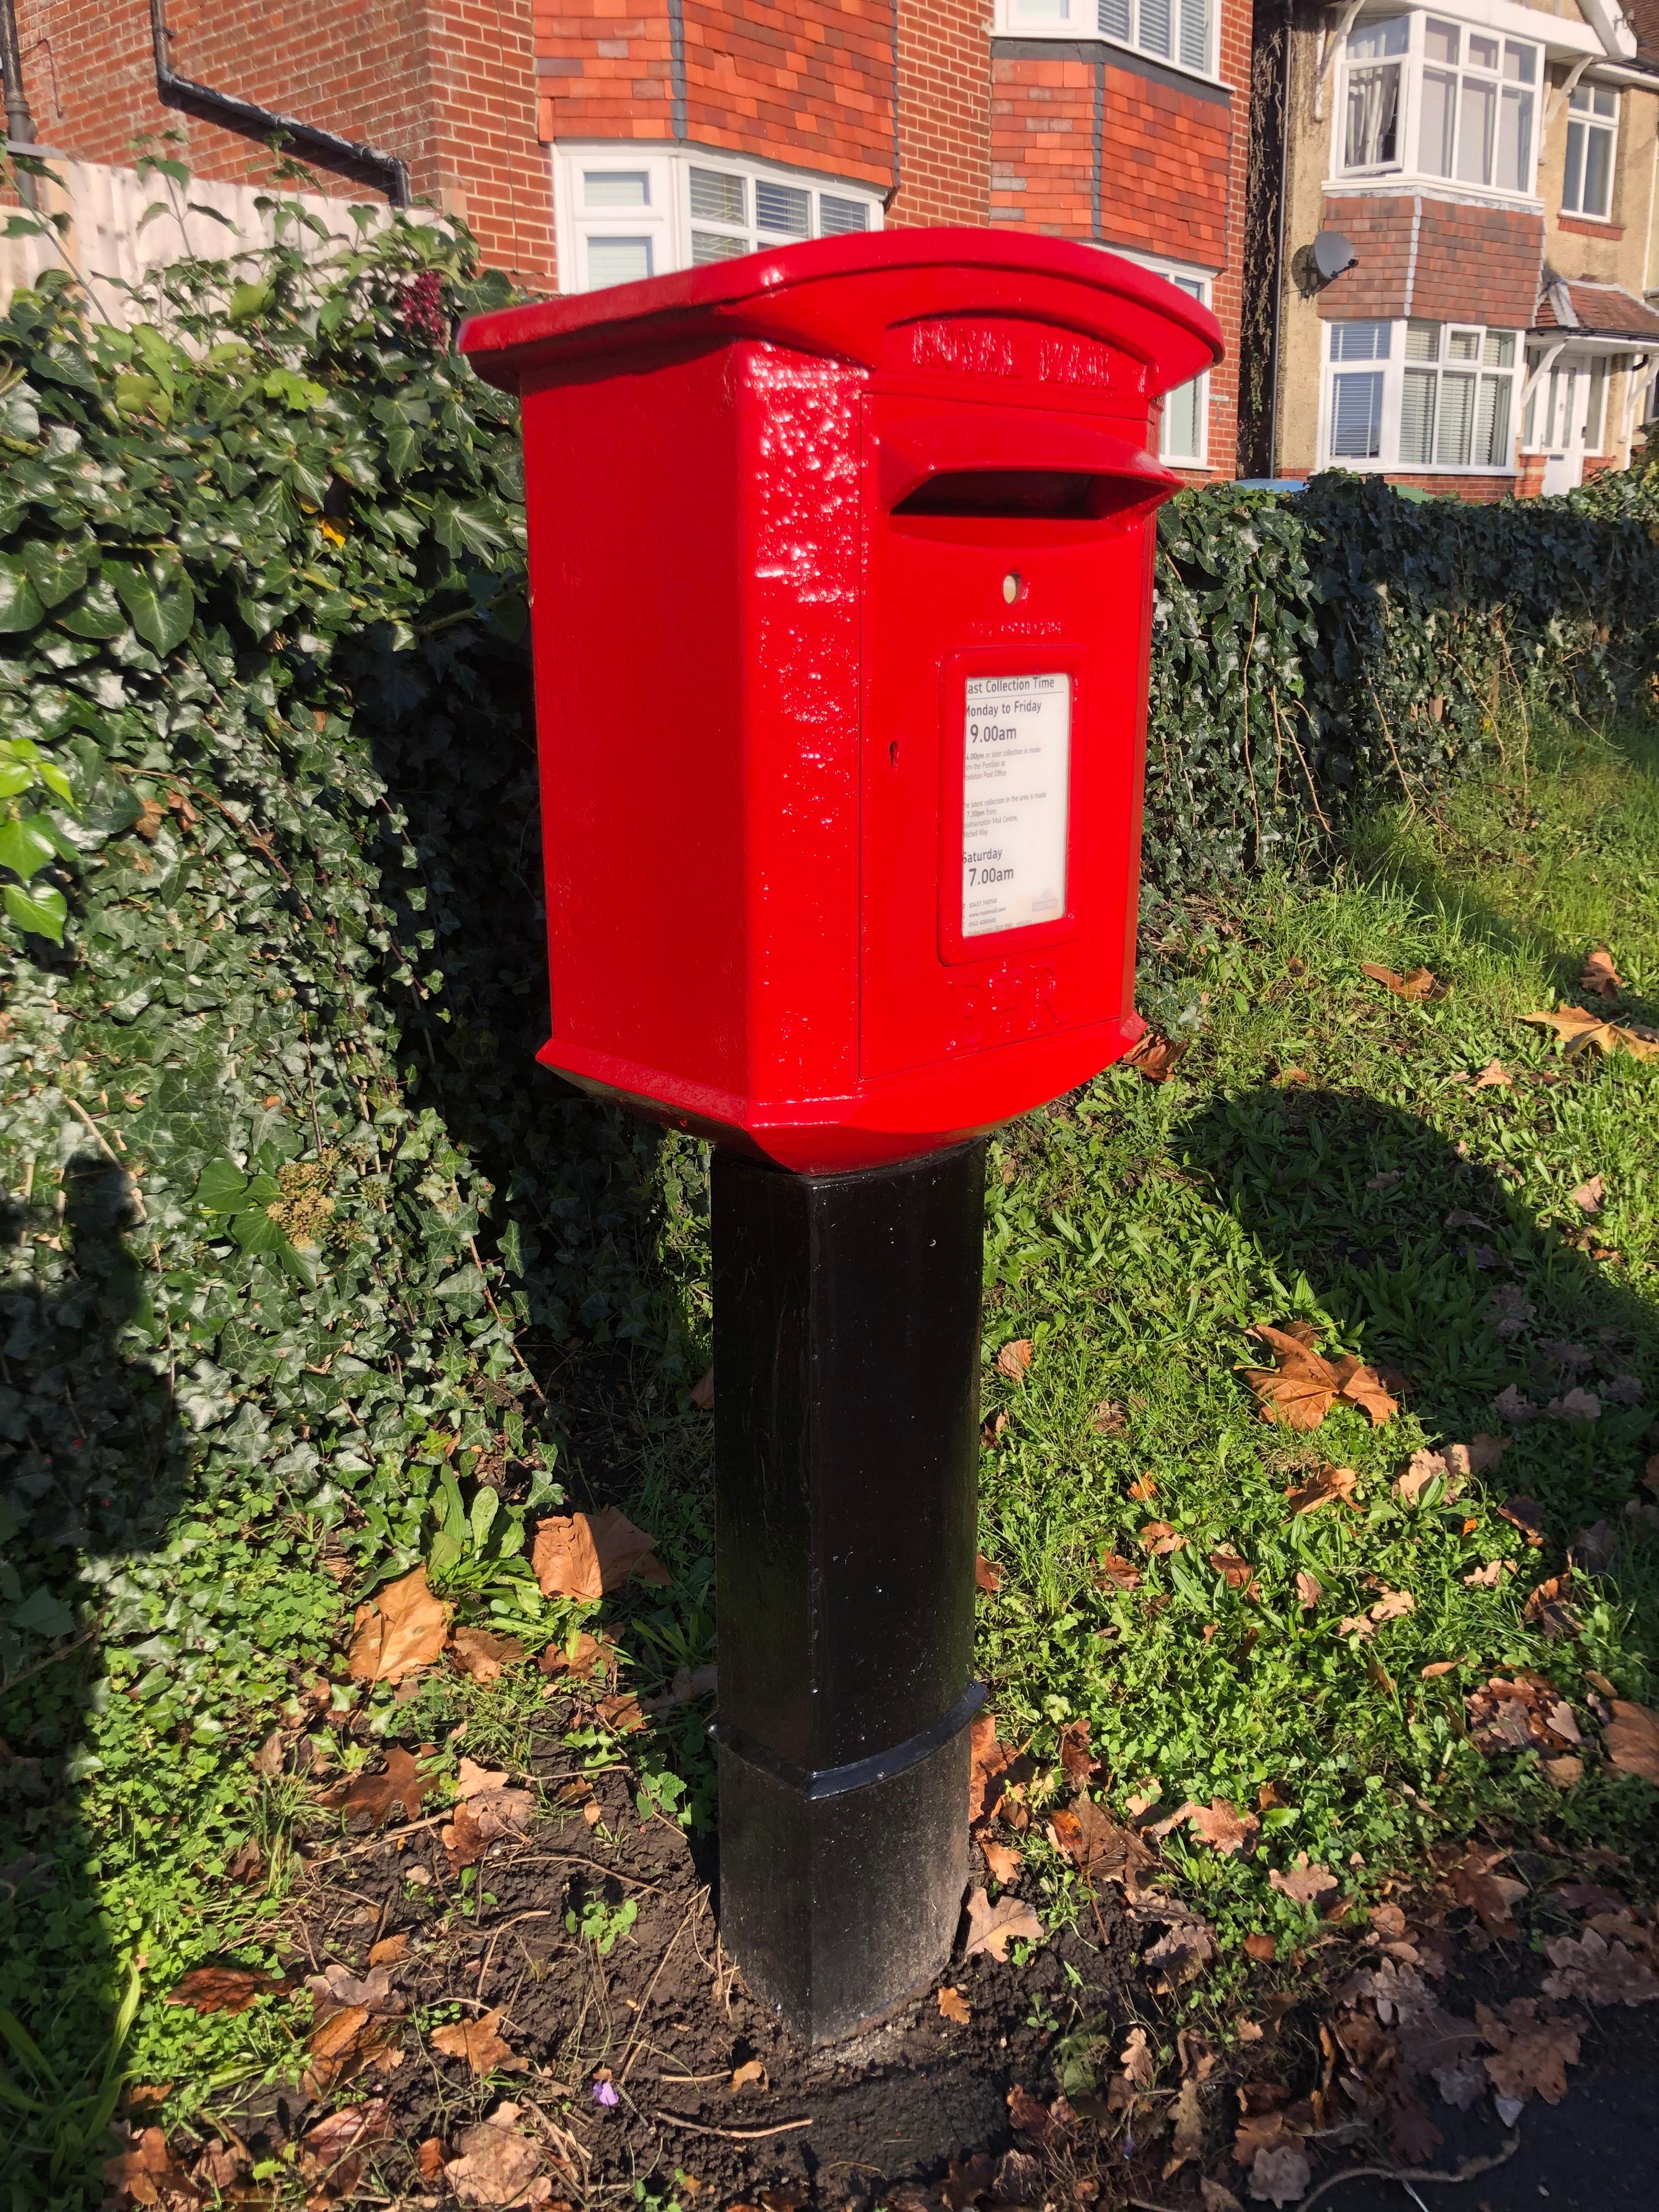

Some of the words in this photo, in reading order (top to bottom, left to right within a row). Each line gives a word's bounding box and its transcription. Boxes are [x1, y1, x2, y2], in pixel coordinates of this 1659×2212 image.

[967, 682, 982, 694] ast
[987, 678, 1030, 692] Collection
[1033, 676, 1054, 690] Time
[1002, 703, 1011, 714] to
[1014, 700, 1042, 714] Friday
[970, 724, 1017, 743] 9.00am
[1003, 748, 1023, 757] collection
[984, 798, 1005, 806] collection
[1035, 790, 1047, 799] made
[964, 820, 991, 828] outhampton
[992, 816, 1002, 824] Mail
[967, 810, 985, 819] 7.30pm
[963, 848, 1003, 864] Saturday
[969, 867, 1014, 887] 7.00am
